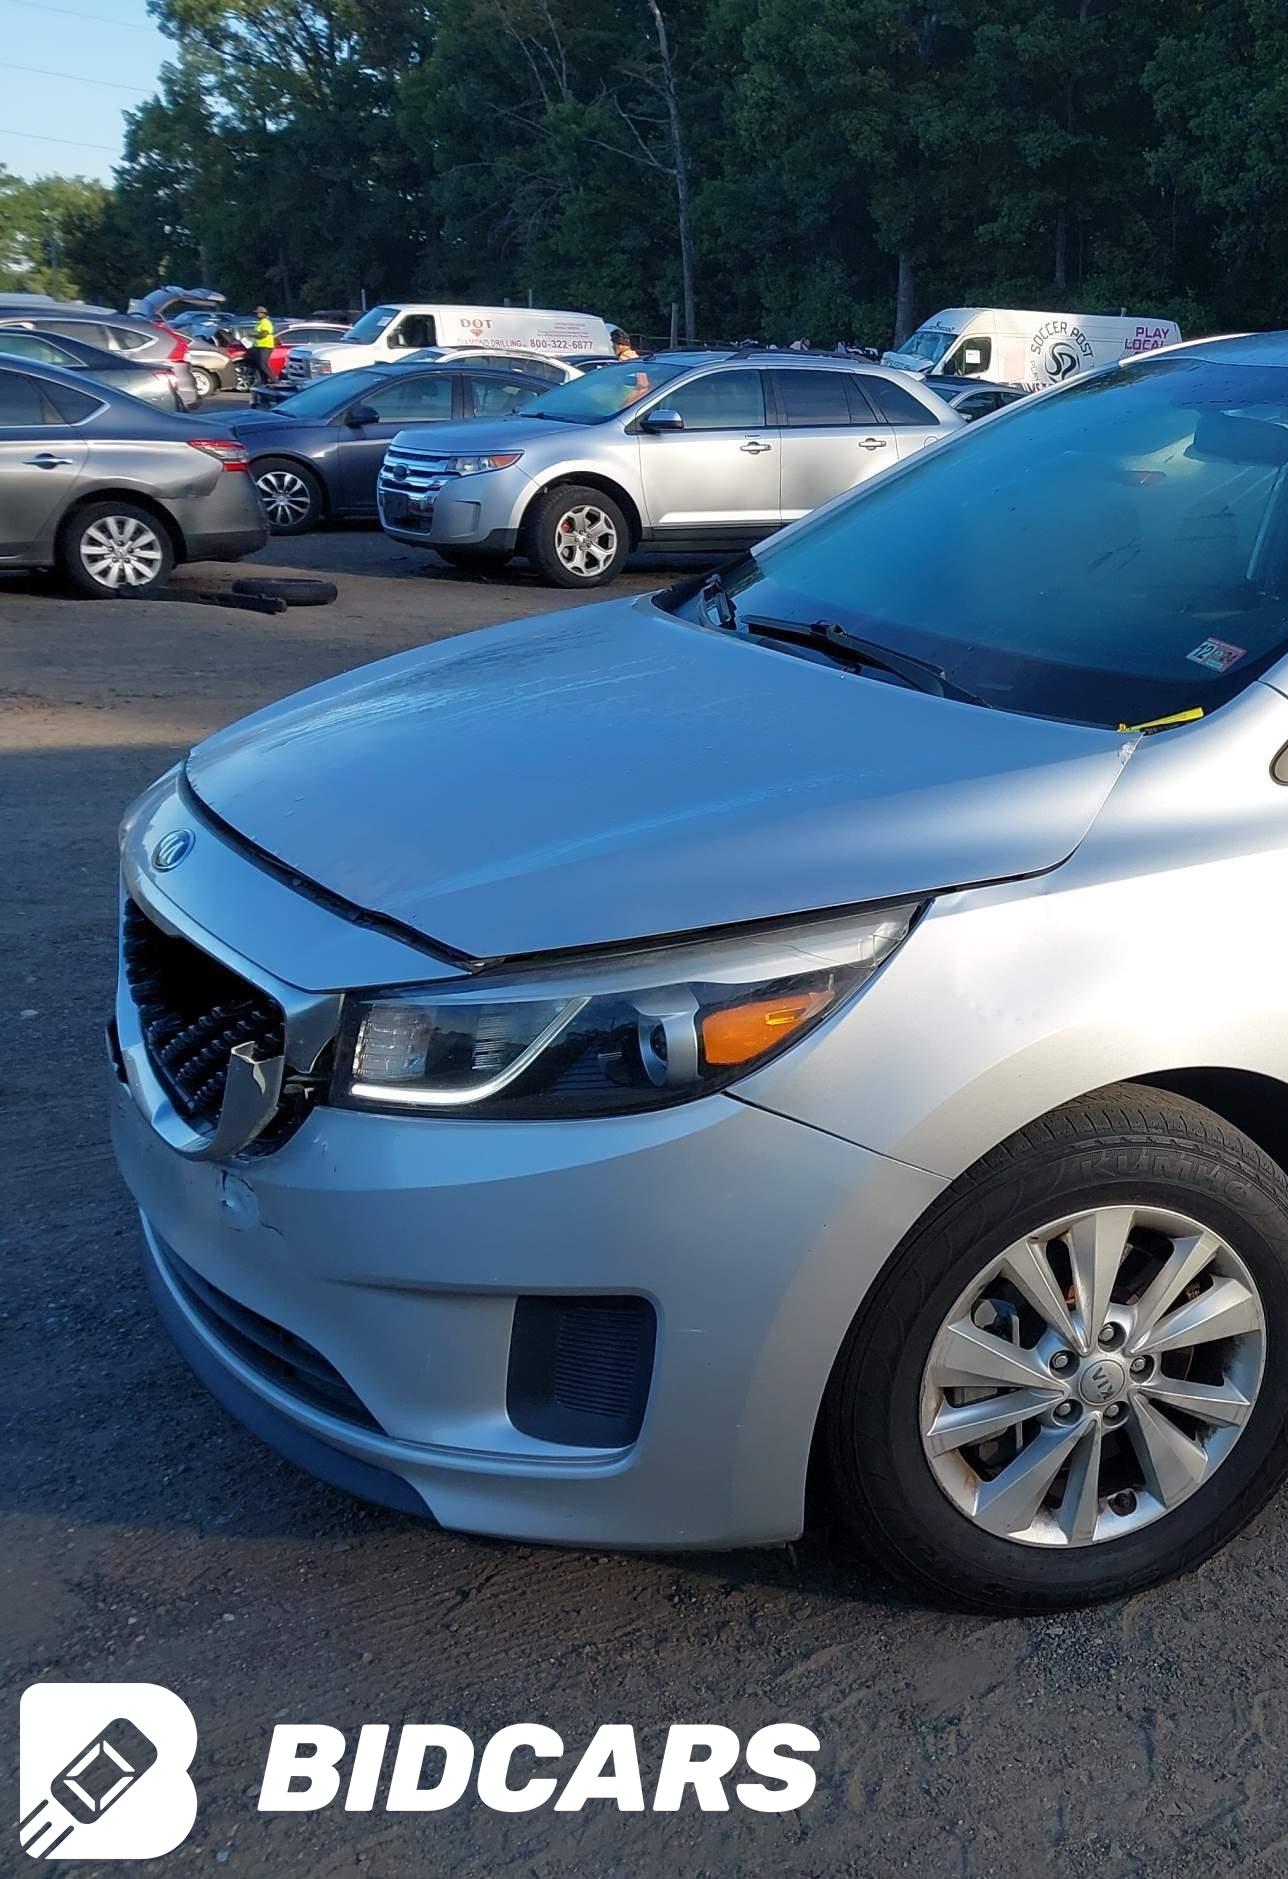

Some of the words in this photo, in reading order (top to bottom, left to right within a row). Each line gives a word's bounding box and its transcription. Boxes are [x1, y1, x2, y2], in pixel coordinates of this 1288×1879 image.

[460, 319, 493, 329] DOT
[1135, 326, 1170, 339] PLAY
[490, 338, 522, 348] DRILLING
[1030, 321, 1068, 356] SOCCER
[1070, 326, 1094, 359] POST
[1193, 643, 1215, 659] 12
[1091, 1365, 1117, 1401] KIA
